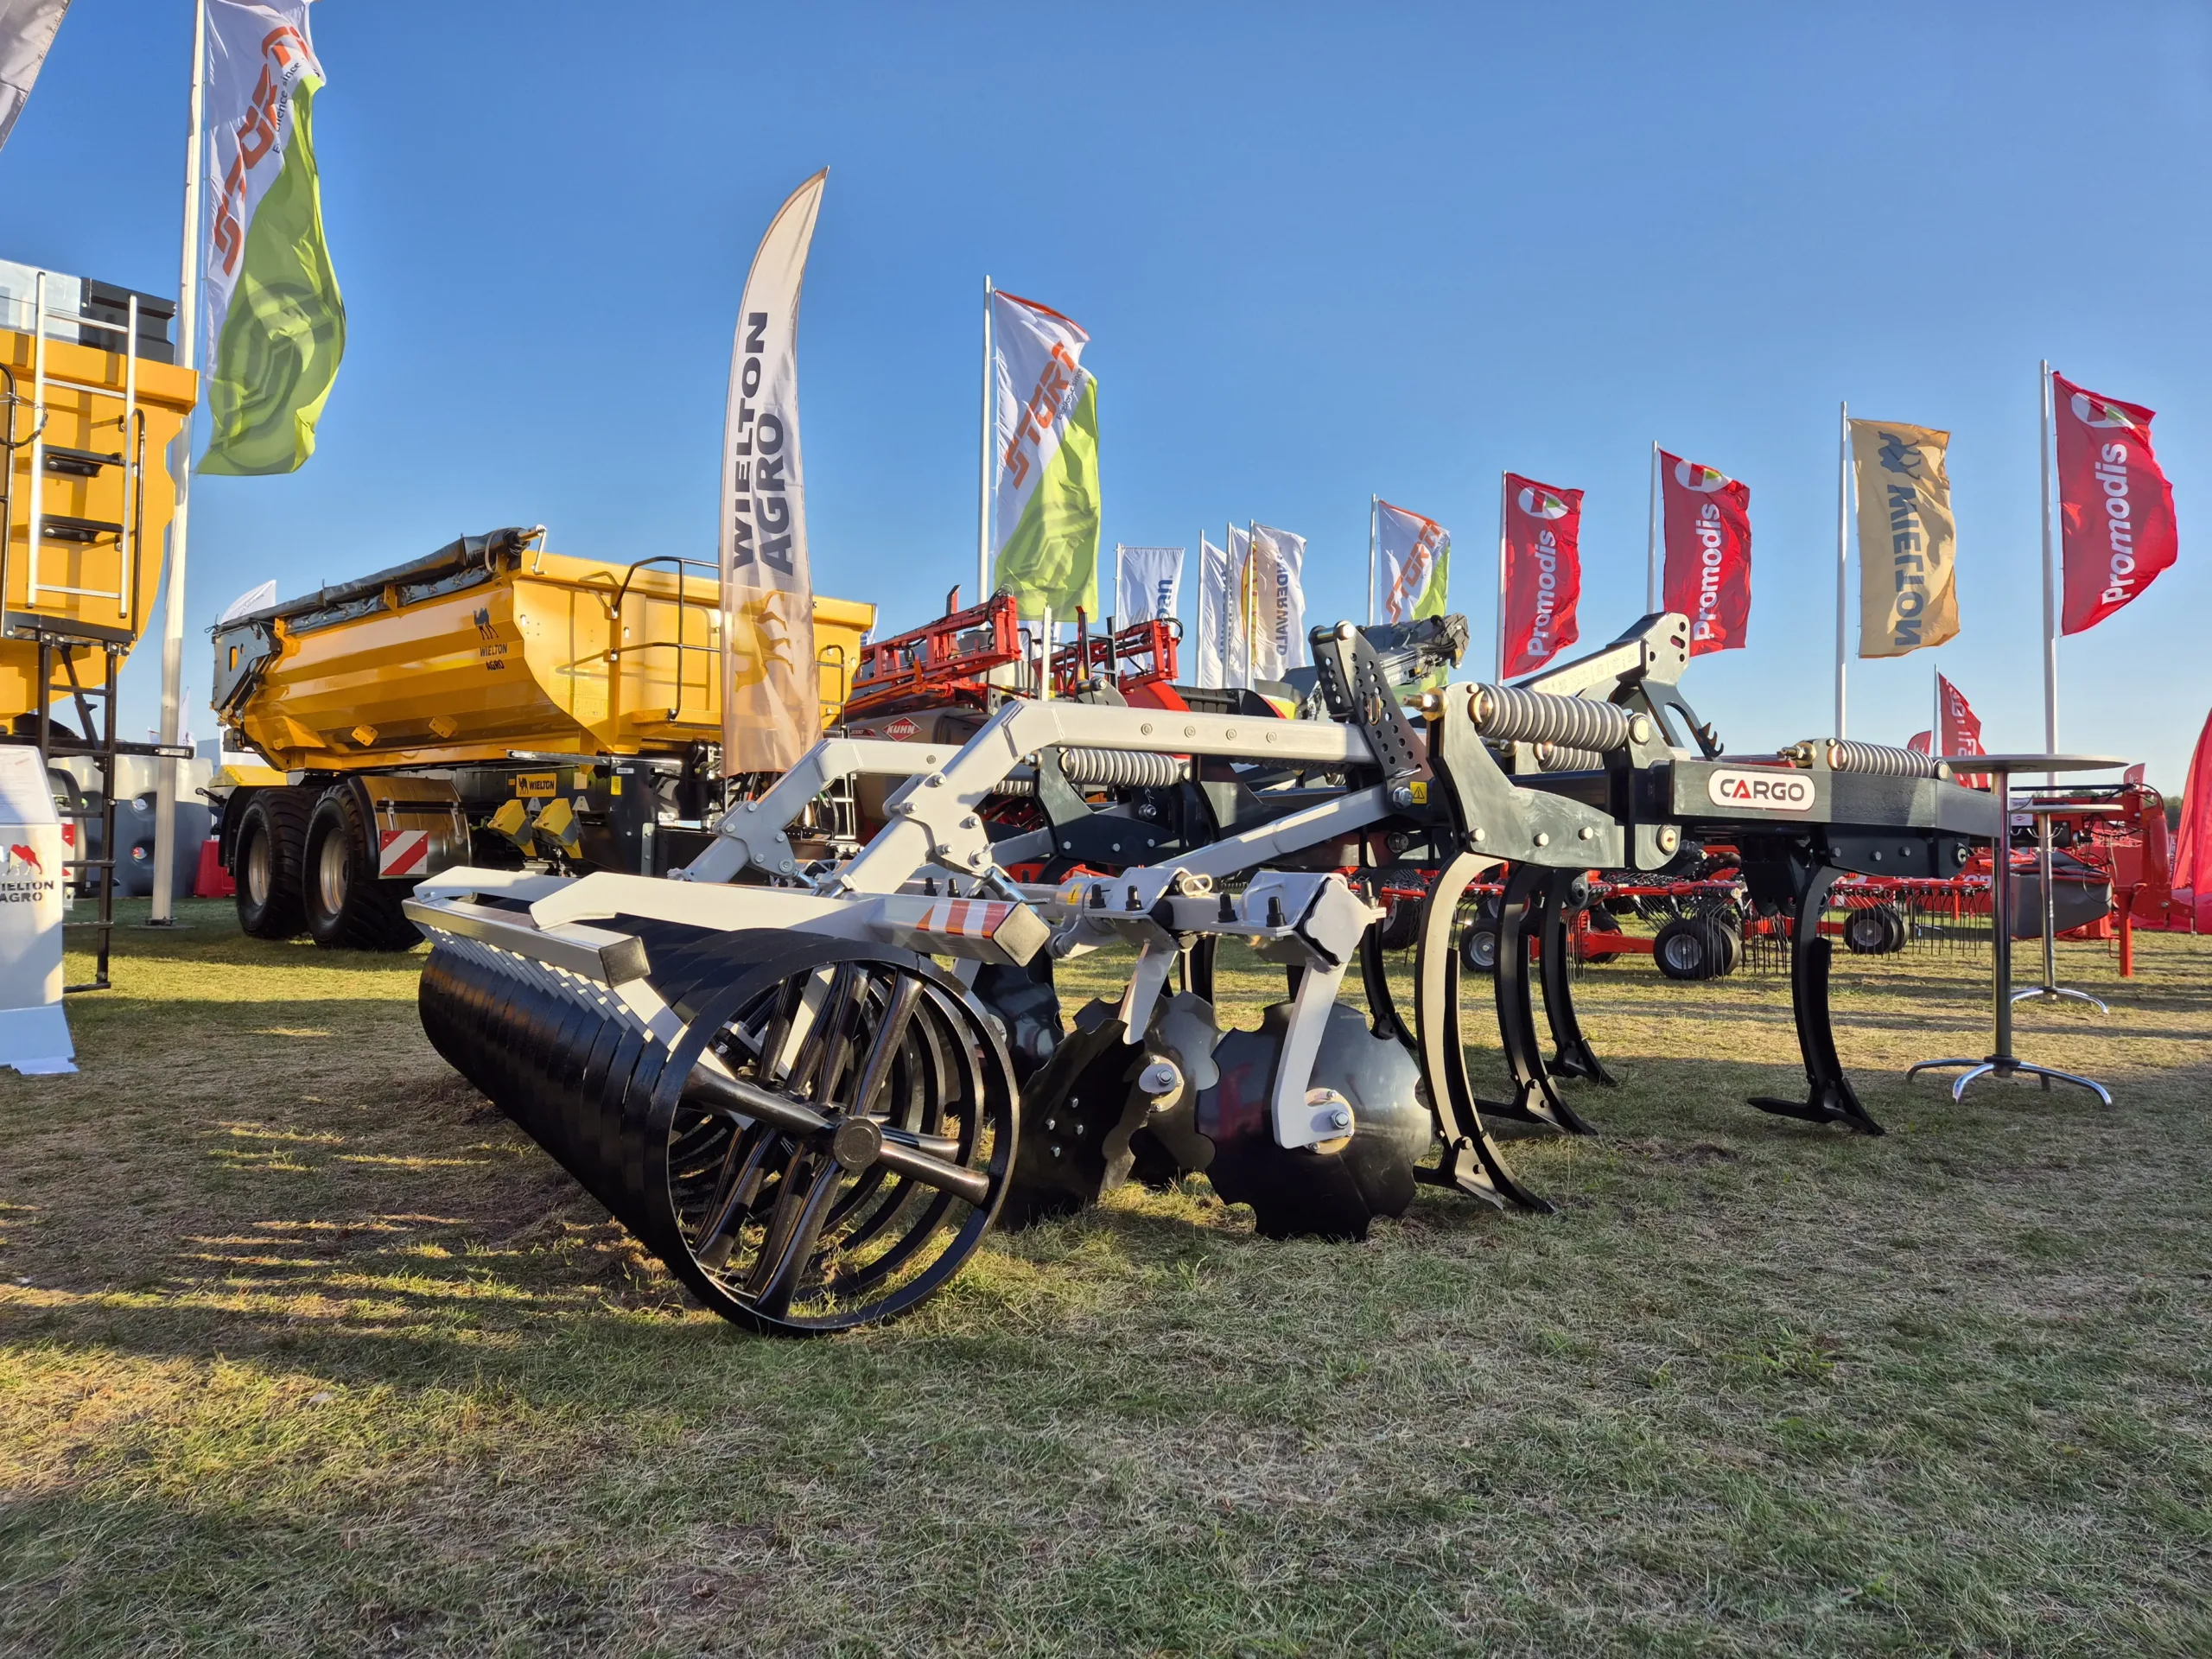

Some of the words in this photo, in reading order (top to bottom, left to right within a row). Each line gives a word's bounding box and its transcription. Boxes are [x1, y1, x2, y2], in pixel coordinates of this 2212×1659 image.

[283, 62, 300, 86] since
[1004, 340, 1075, 490] STORT
[734, 312, 768, 570] WIELTON
[756, 413, 793, 576] AGRO
[2094, 443, 2135, 606] Promodis
[1693, 503, 1722, 641] Promodis
[1528, 530, 1556, 657] Promodis
[480, 643, 508, 657] WIELTON
[486, 659, 505, 671] AGRO
[887, 725, 915, 734] KUHN
[529, 779, 555, 791] WIELTON
[1719, 779, 1805, 802] CARGO
[0, 880, 54, 891] IELTON
